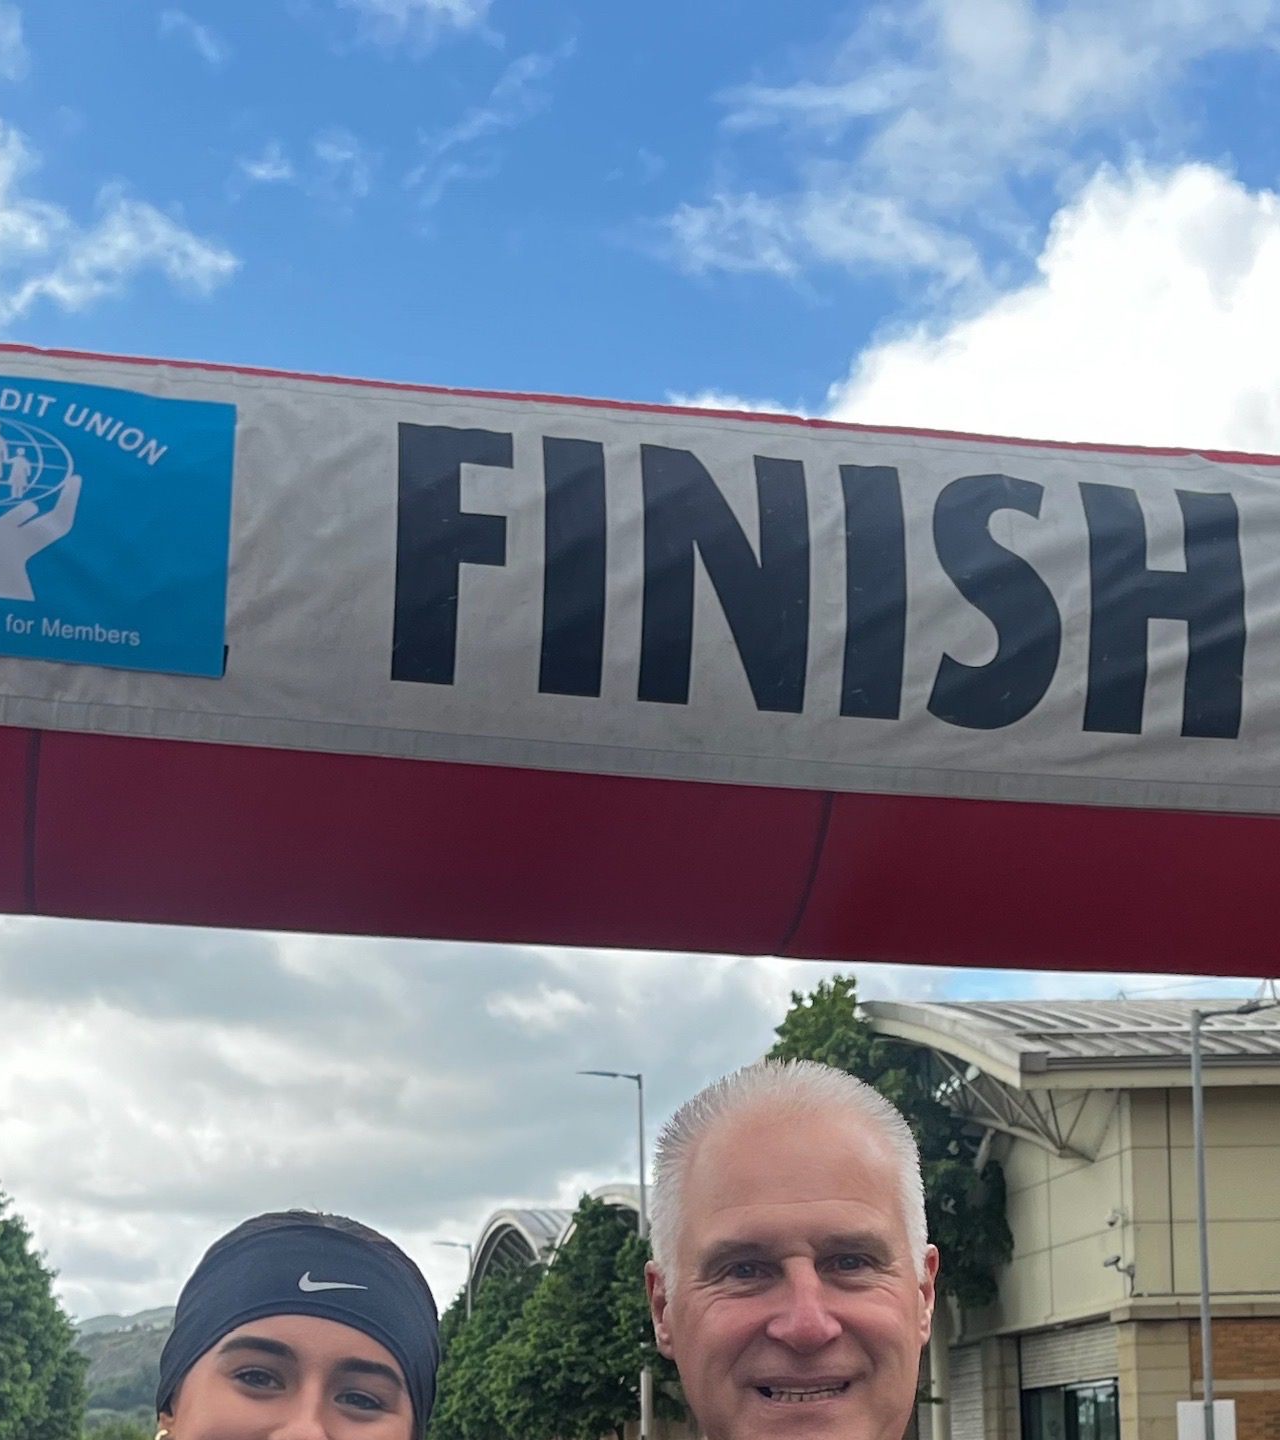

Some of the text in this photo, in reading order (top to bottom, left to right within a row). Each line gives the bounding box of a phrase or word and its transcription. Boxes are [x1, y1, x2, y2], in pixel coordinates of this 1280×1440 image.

[63, 403, 167, 466] UNION
[391, 421, 1246, 740] FINISH
[5, 612, 35, 635] for
[41, 617, 141, 647] Members
